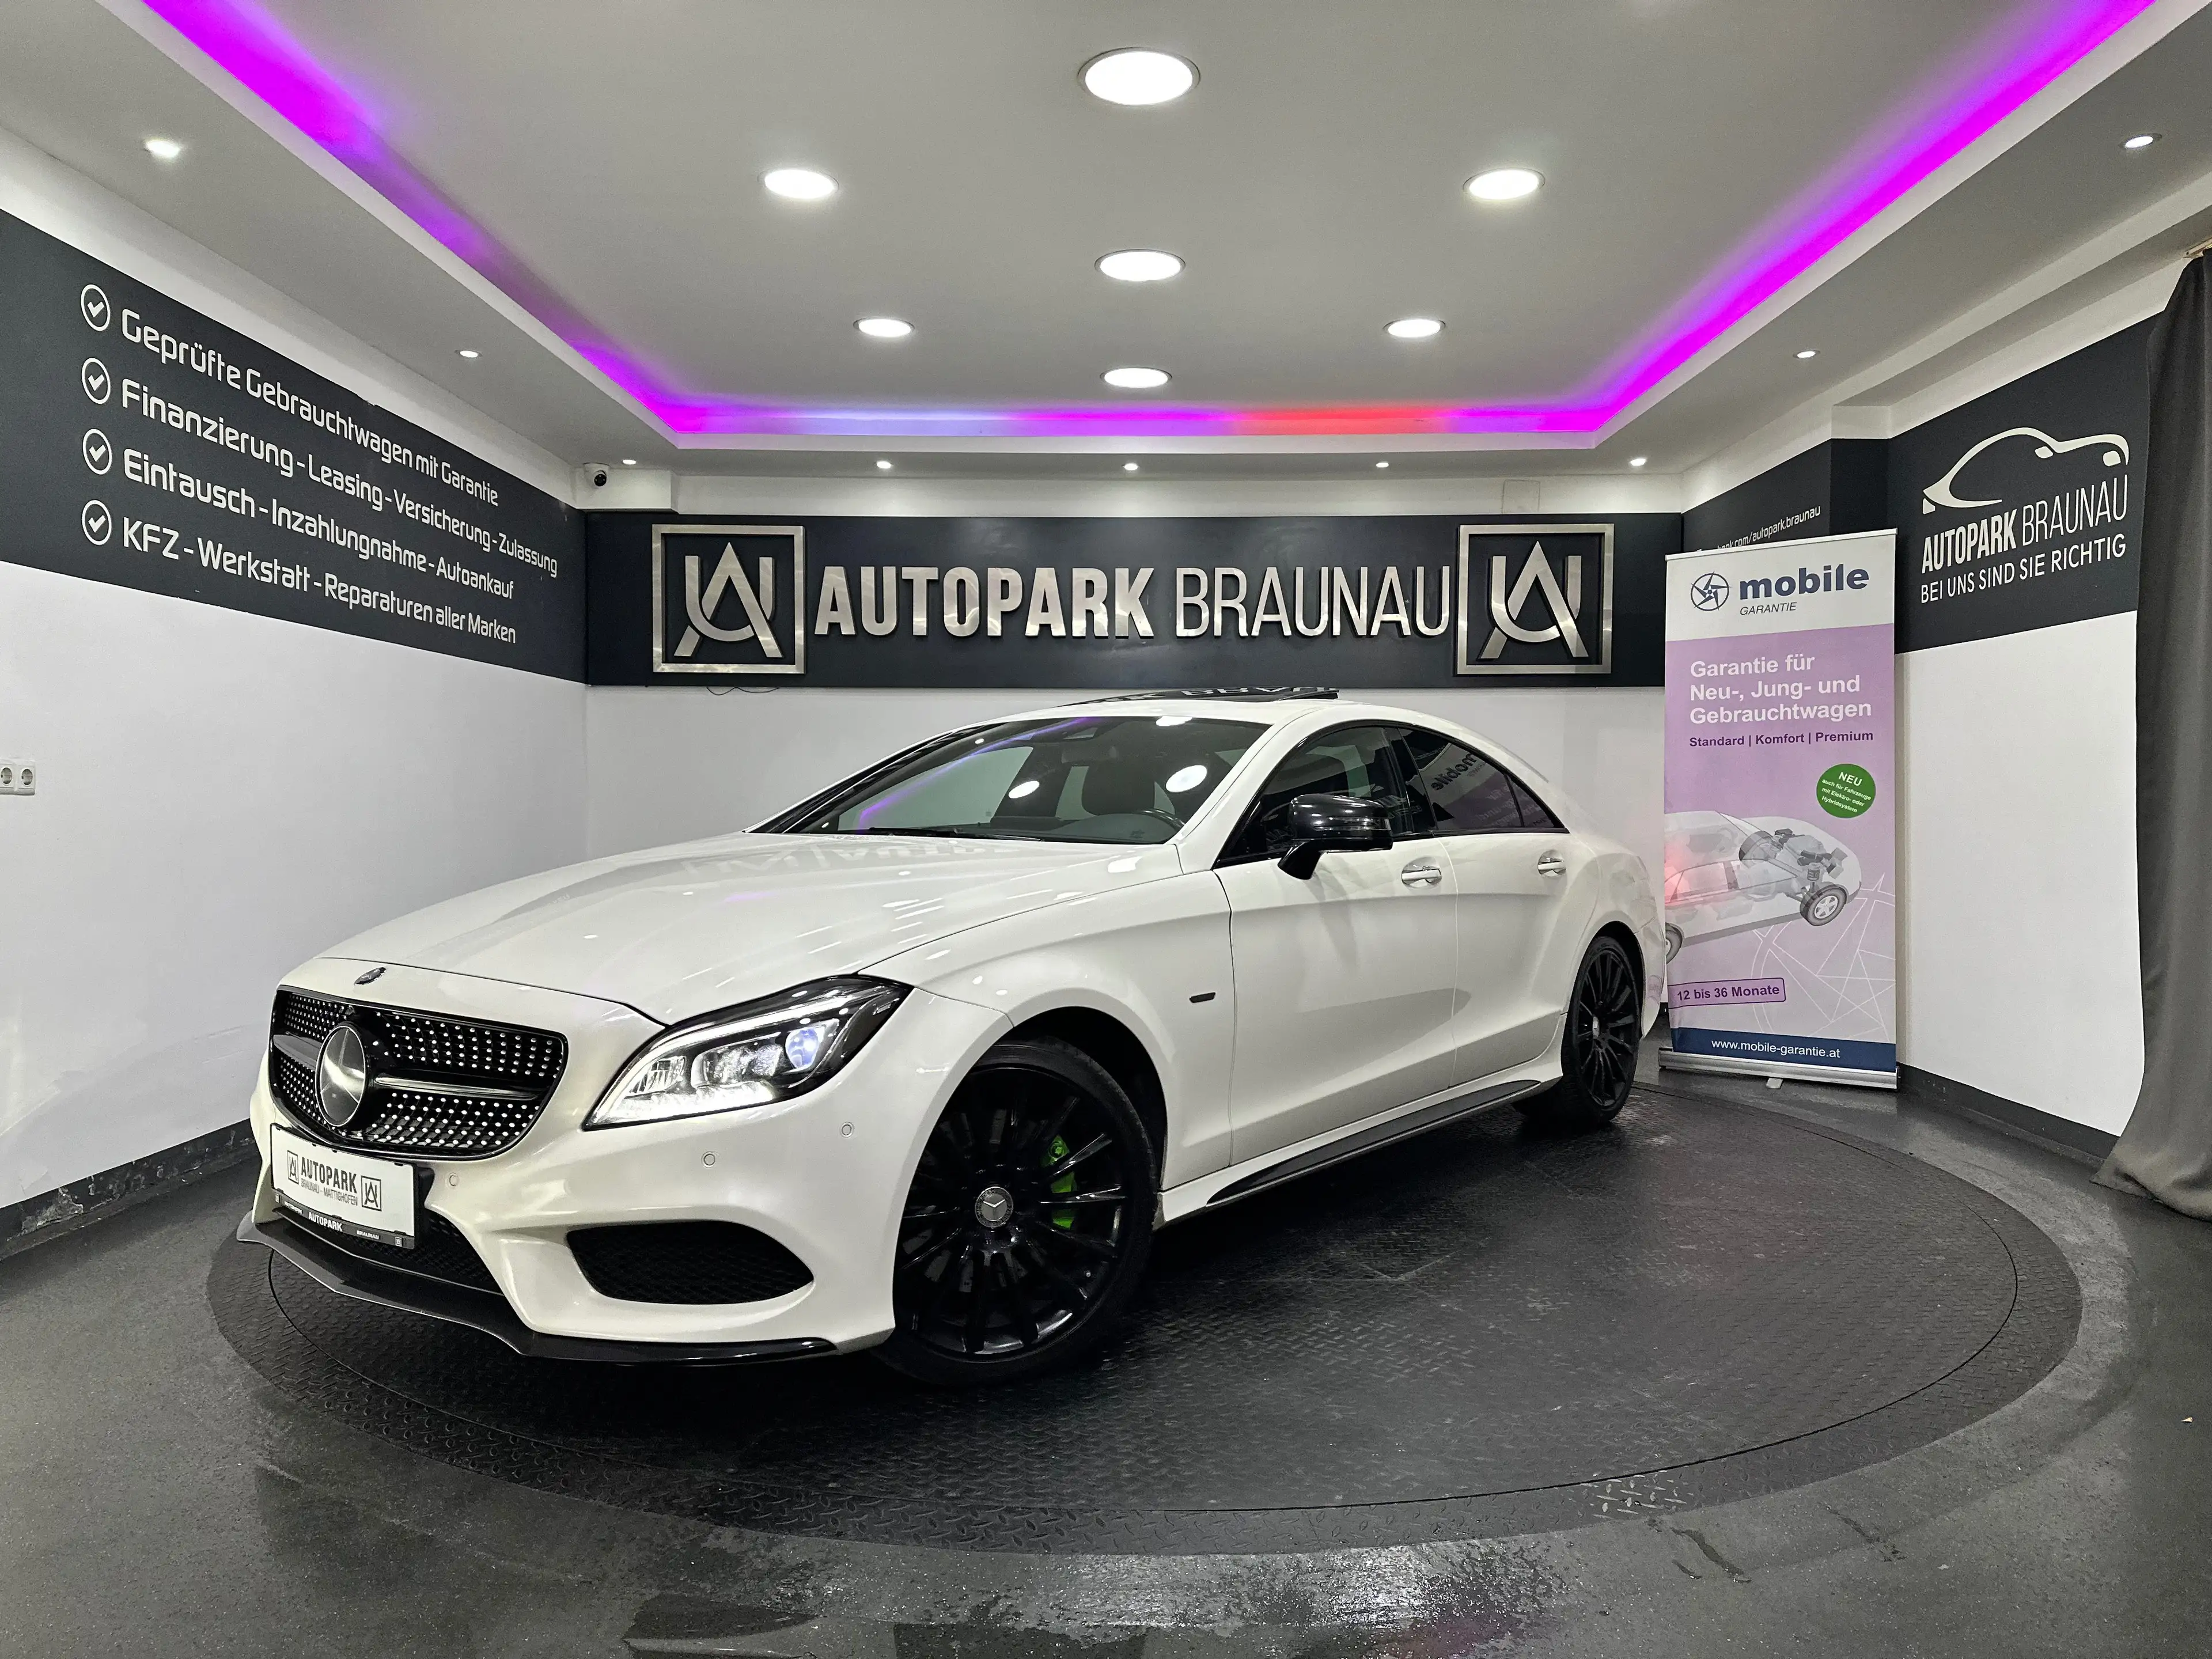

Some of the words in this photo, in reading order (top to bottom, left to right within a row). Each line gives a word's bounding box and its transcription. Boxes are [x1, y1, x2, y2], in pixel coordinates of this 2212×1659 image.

[122, 308, 241, 390] Geprüfte
[247, 368, 412, 467] Gebrauchtwagen
[416, 454, 438, 479] mit
[441, 461, 499, 506] Garantie
[122, 378, 293, 478] Finanzierung
[308, 454, 382, 512] Leasing
[393, 489, 490, 552] Versicherung
[499, 532, 558, 578] Zulassung
[124, 448, 255, 518] Eintausch
[272, 498, 426, 572] Inzahlungnahme
[436, 556, 514, 599] Autoankauf
[1921, 509, 2017, 574] AUTOPARK
[2022, 475, 2128, 546] BRAUNAU
[1921, 580, 1942, 604] BEI
[1948, 572, 1974, 596] UNS
[1979, 562, 2015, 590] SIND
[2020, 554, 2046, 580] SIE
[2052, 533, 2126, 573] RICHTIG
[123, 517, 179, 560] KFZ
[197, 537, 310, 592] Werkstatt
[325, 573, 433, 623] Reparaturen
[435, 605, 466, 630] aller
[468, 612, 516, 644] Marken
[1740, 563, 1869, 600] mobile
[814, 566, 1154, 637] AUTOPARK
[1176, 566, 1450, 637] BRAUNAU
[1740, 602, 1797, 615] GARANTIE
[1690, 657, 1779, 677] Garantie
[1785, 654, 1815, 672] für
[1690, 684, 1744, 702] Neu-,
[1751, 681, 1811, 699] Jung-
[1819, 675, 1860, 694] und
[1690, 703, 1872, 724] Gebrauchtwagen
[1689, 736, 1745, 747] Standard
[1755, 733, 1805, 745] Komfort
[1816, 731, 1873, 743] Premium
[1821, 779, 1835, 787] auch
[1844, 786, 1872, 800] Fahrzeuge
[1839, 772, 1862, 786] NEU
[1821, 796, 1858, 813] Hybridsystem
[1831, 790, 1851, 801] Elektro-
[1677, 990, 1690, 1001] 12
[1694, 988, 1711, 999] bis
[1714, 987, 1728, 998] 36
[1732, 985, 1780, 997] Monate
[1711, 1040, 1841, 1058] www.mobile-garantie.at
[301, 1157, 357, 1194] AUTOPARK
[323, 1187, 358, 1206] MATTIGHOFEN
[308, 1211, 343, 1232] AUTOPARK
